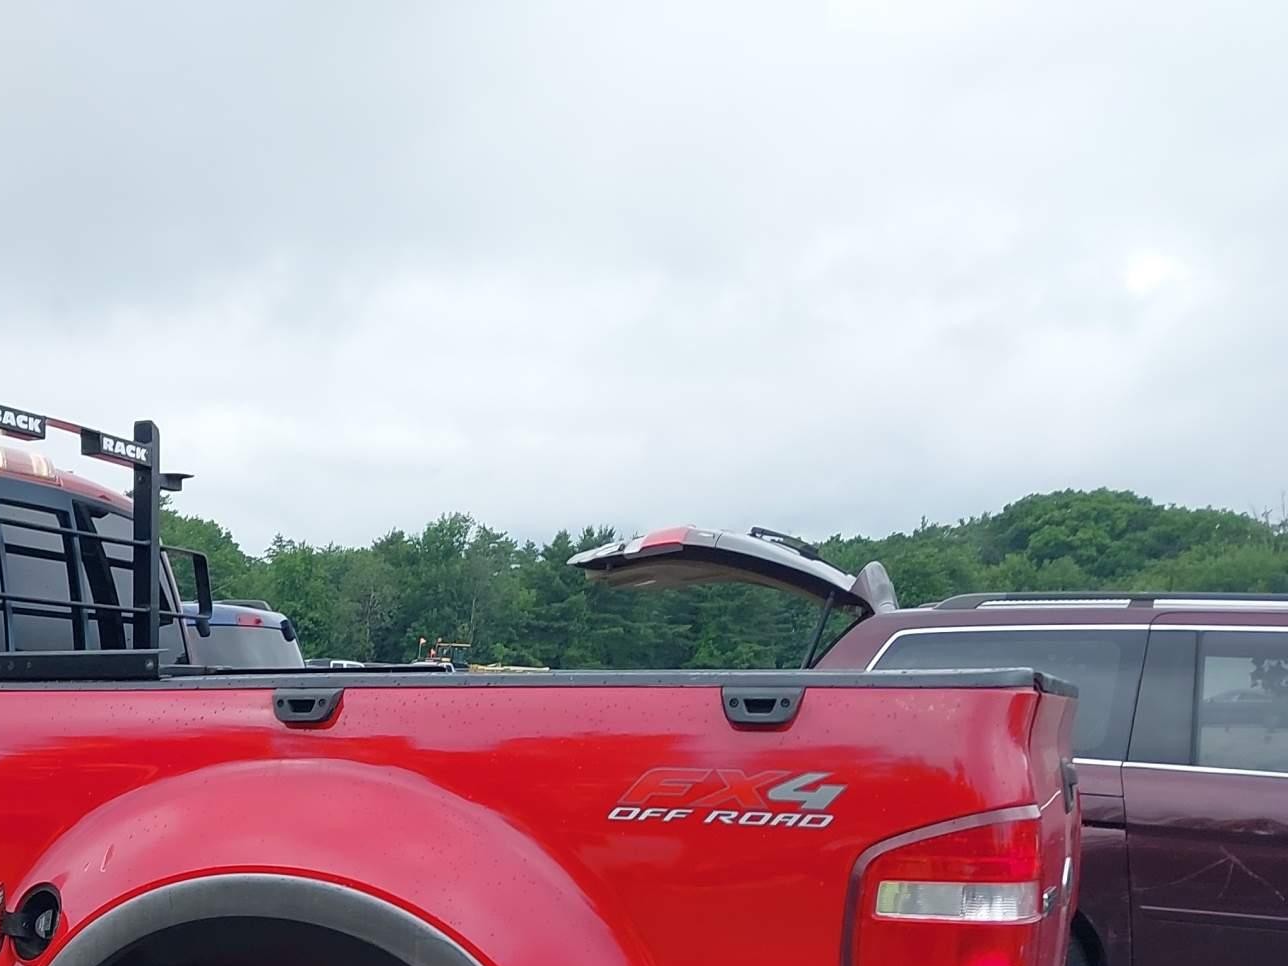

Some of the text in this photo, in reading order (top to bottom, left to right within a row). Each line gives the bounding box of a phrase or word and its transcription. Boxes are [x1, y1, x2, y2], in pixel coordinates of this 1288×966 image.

[102, 436, 148, 462] RACK
[617, 767, 849, 811] FX4
[607, 807, 835, 829] OFF ROAD
